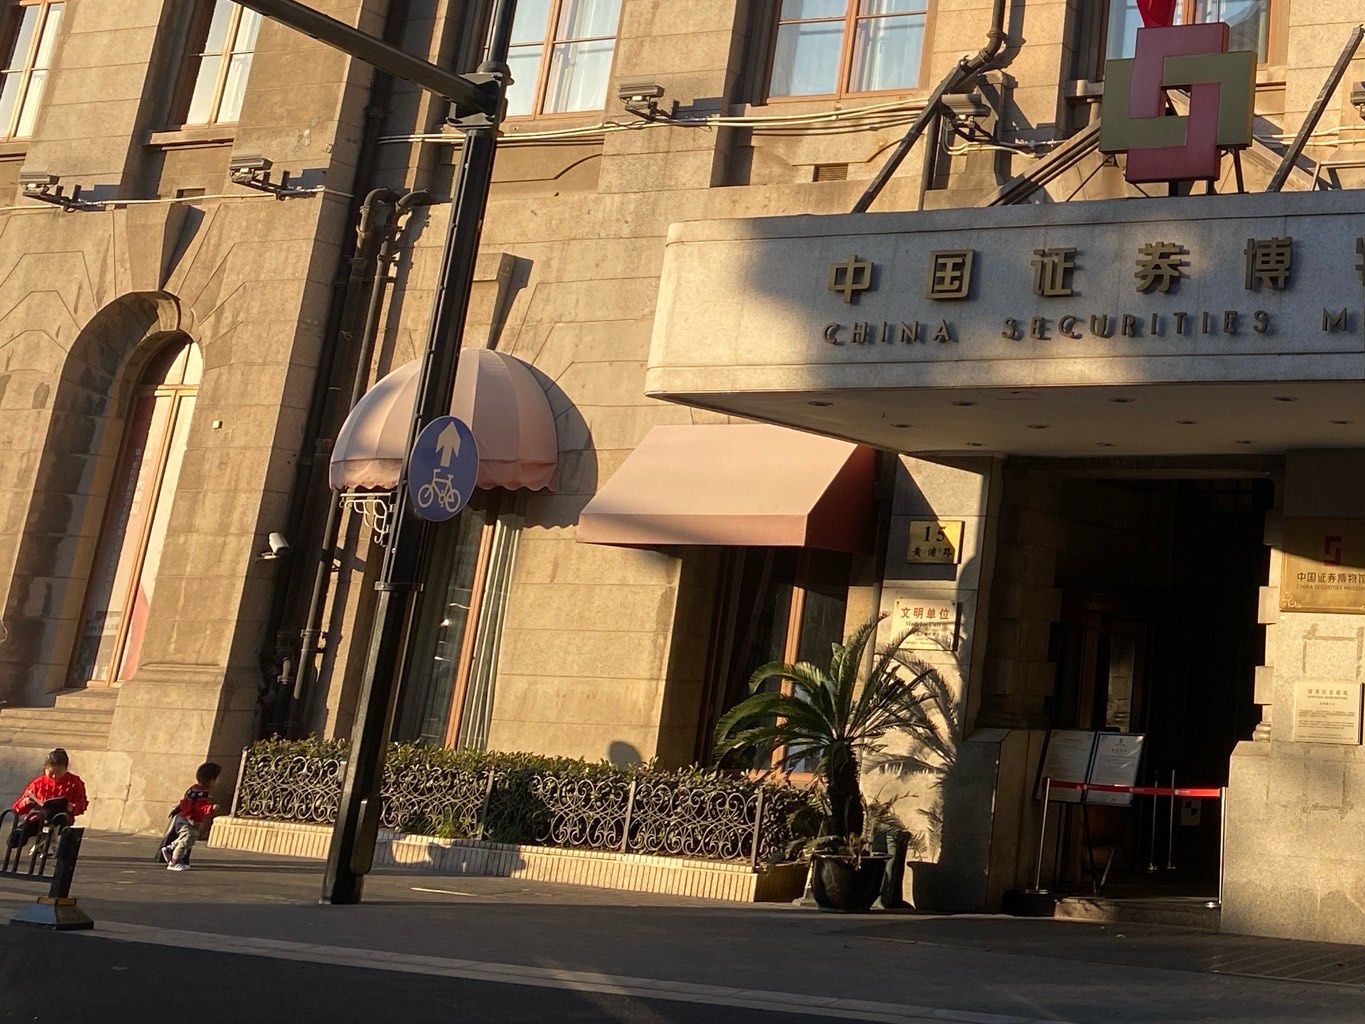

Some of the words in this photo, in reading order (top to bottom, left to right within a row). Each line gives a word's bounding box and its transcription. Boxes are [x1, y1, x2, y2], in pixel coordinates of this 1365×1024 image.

[822, 319, 957, 345] CHINA
[1000, 309, 1272, 341] SECURITIES
[923, 525, 947, 542] 15
[900, 607, 950, 620] 文明单位
